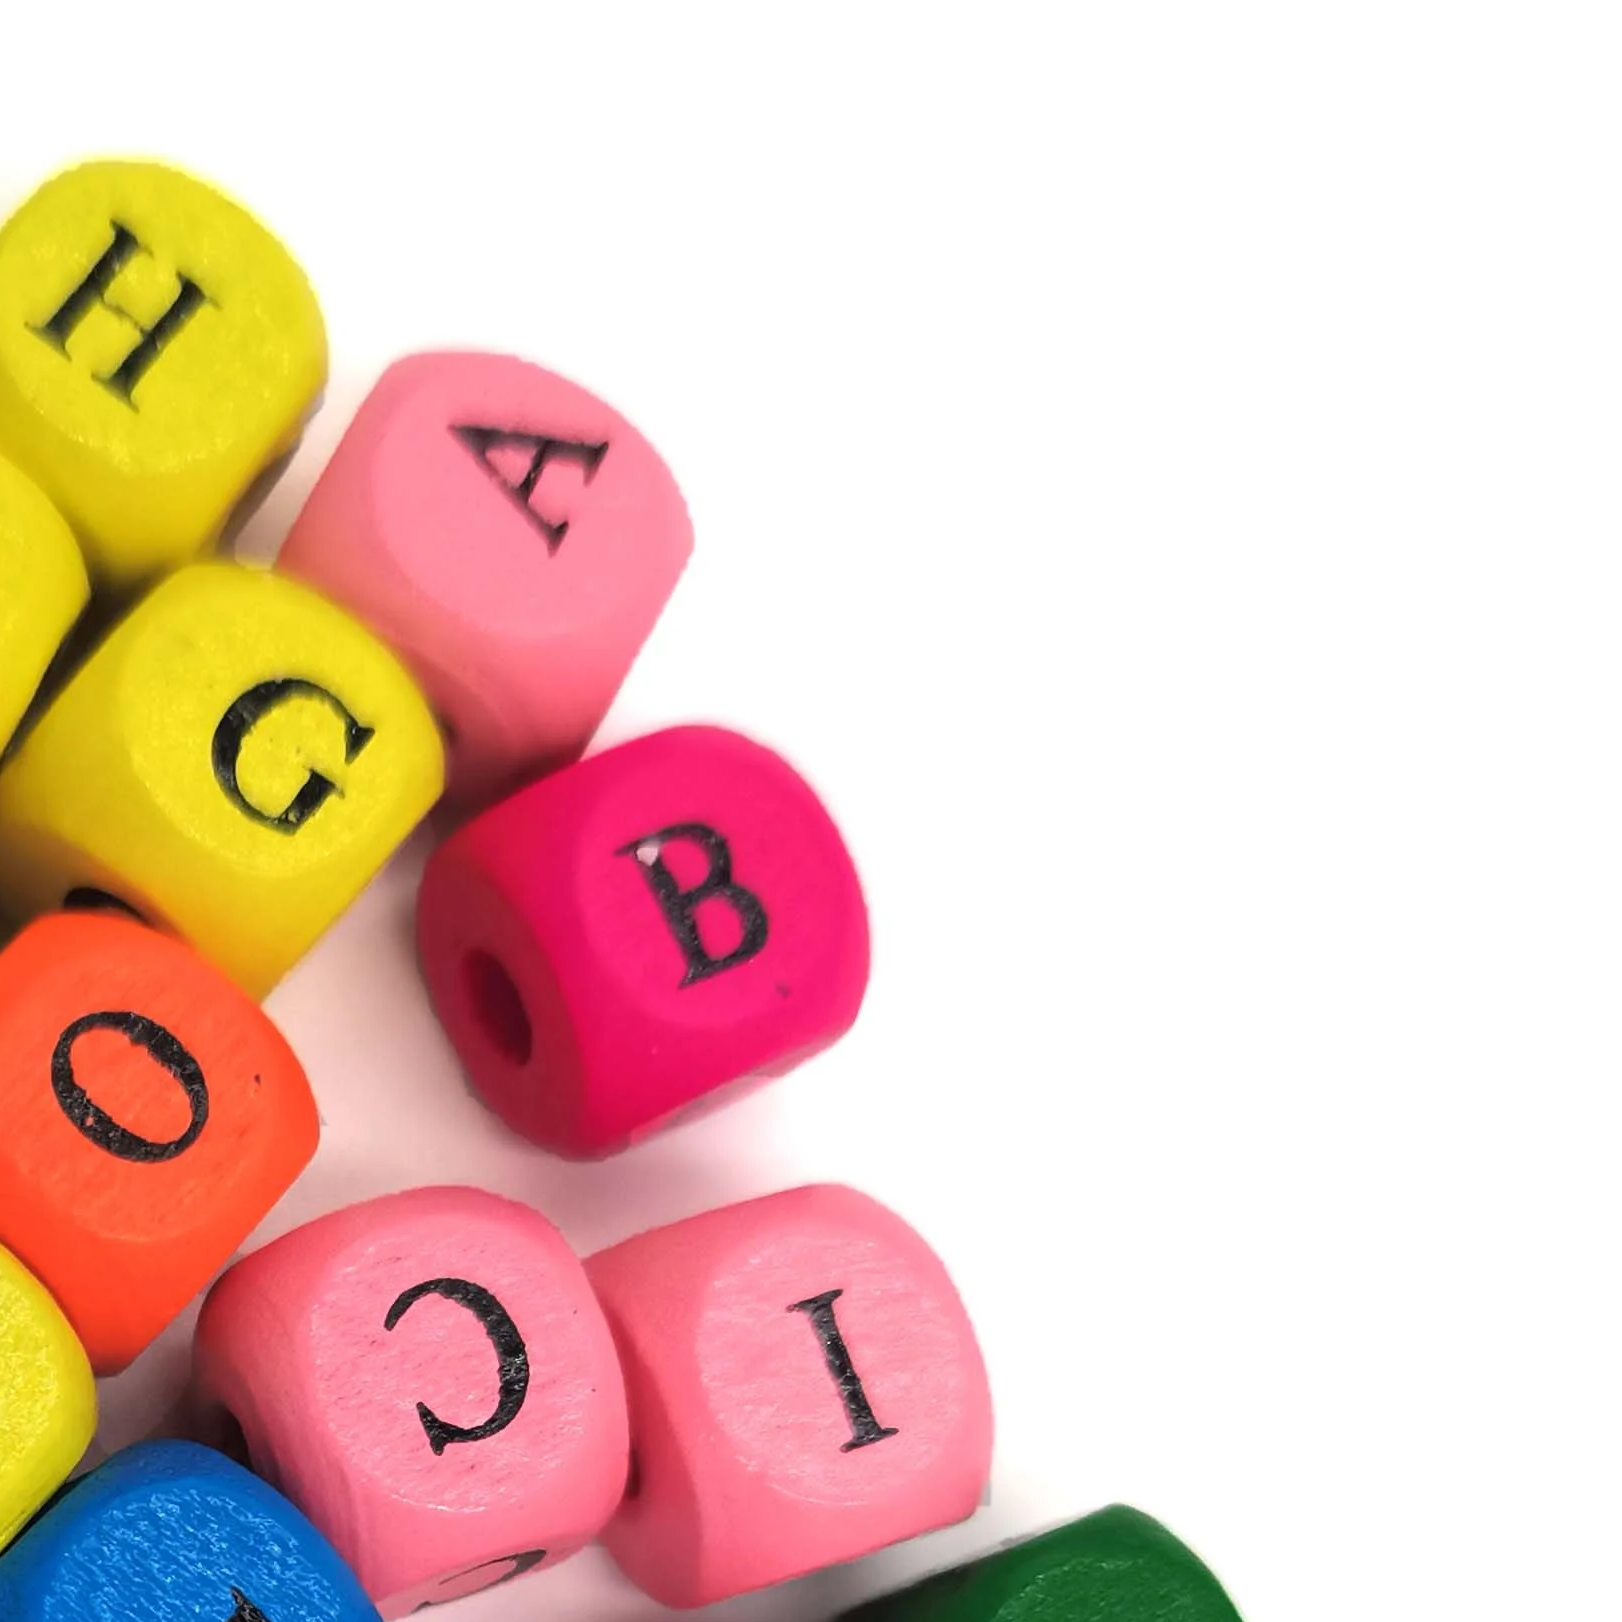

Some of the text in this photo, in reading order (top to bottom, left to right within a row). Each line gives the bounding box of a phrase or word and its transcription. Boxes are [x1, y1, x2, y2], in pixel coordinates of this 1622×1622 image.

[25, 218, 223, 412] H
[451, 420, 611, 553] A
[210, 676, 377, 836] G
[614, 820, 771, 990] B
[51, 1011, 208, 1162] O
[383, 1277, 530, 1457] C
[787, 1287, 900, 1454] I
